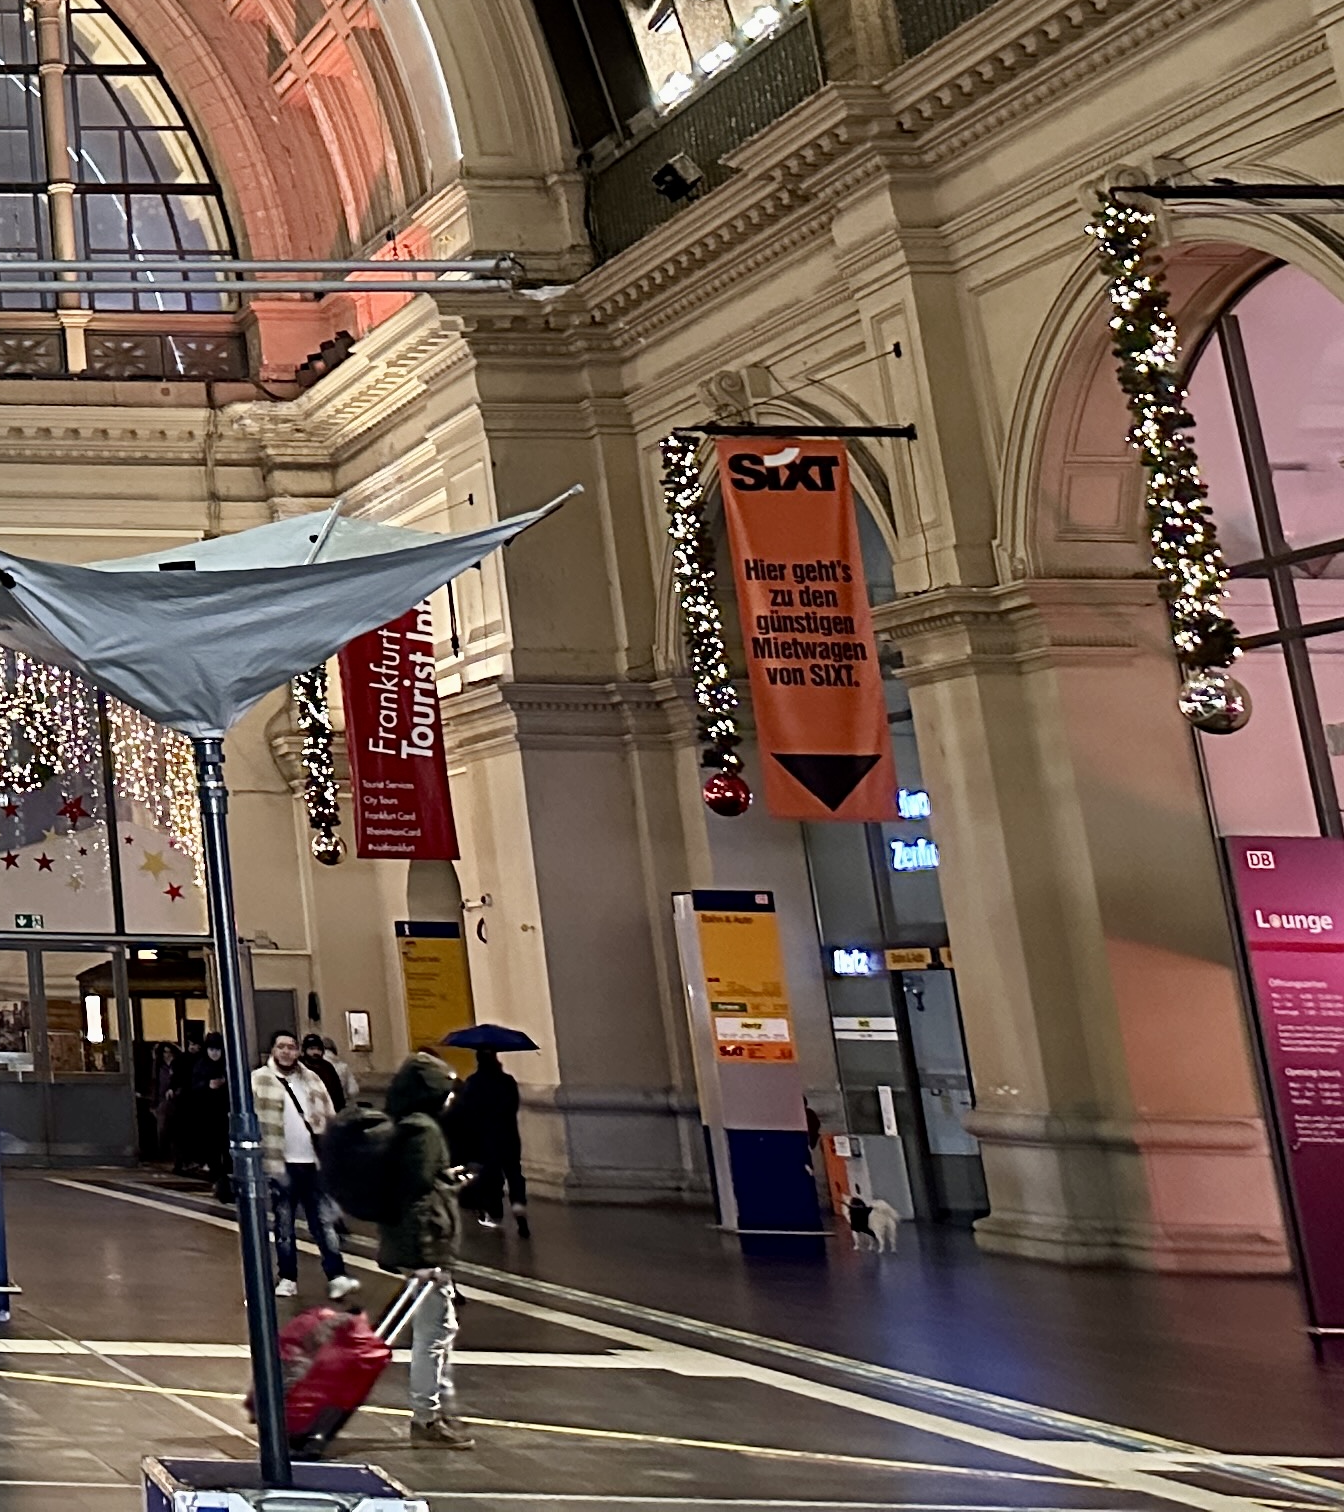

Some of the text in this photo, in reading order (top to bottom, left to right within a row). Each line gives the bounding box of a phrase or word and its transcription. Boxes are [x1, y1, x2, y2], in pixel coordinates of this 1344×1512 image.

[744, 558, 853, 585] Hier geht's
[768, 588, 839, 608] zu den
[756, 611, 856, 636] günstigen
[751, 636, 868, 663] Mietwagen
[765, 663, 861, 687] von SIXT.
[368, 627, 401, 755] Frankfurt
[400, 650, 436, 759] Tourist
[1248, 852, 1274, 868] DB
[1255, 909, 1334, 934] Lounge
